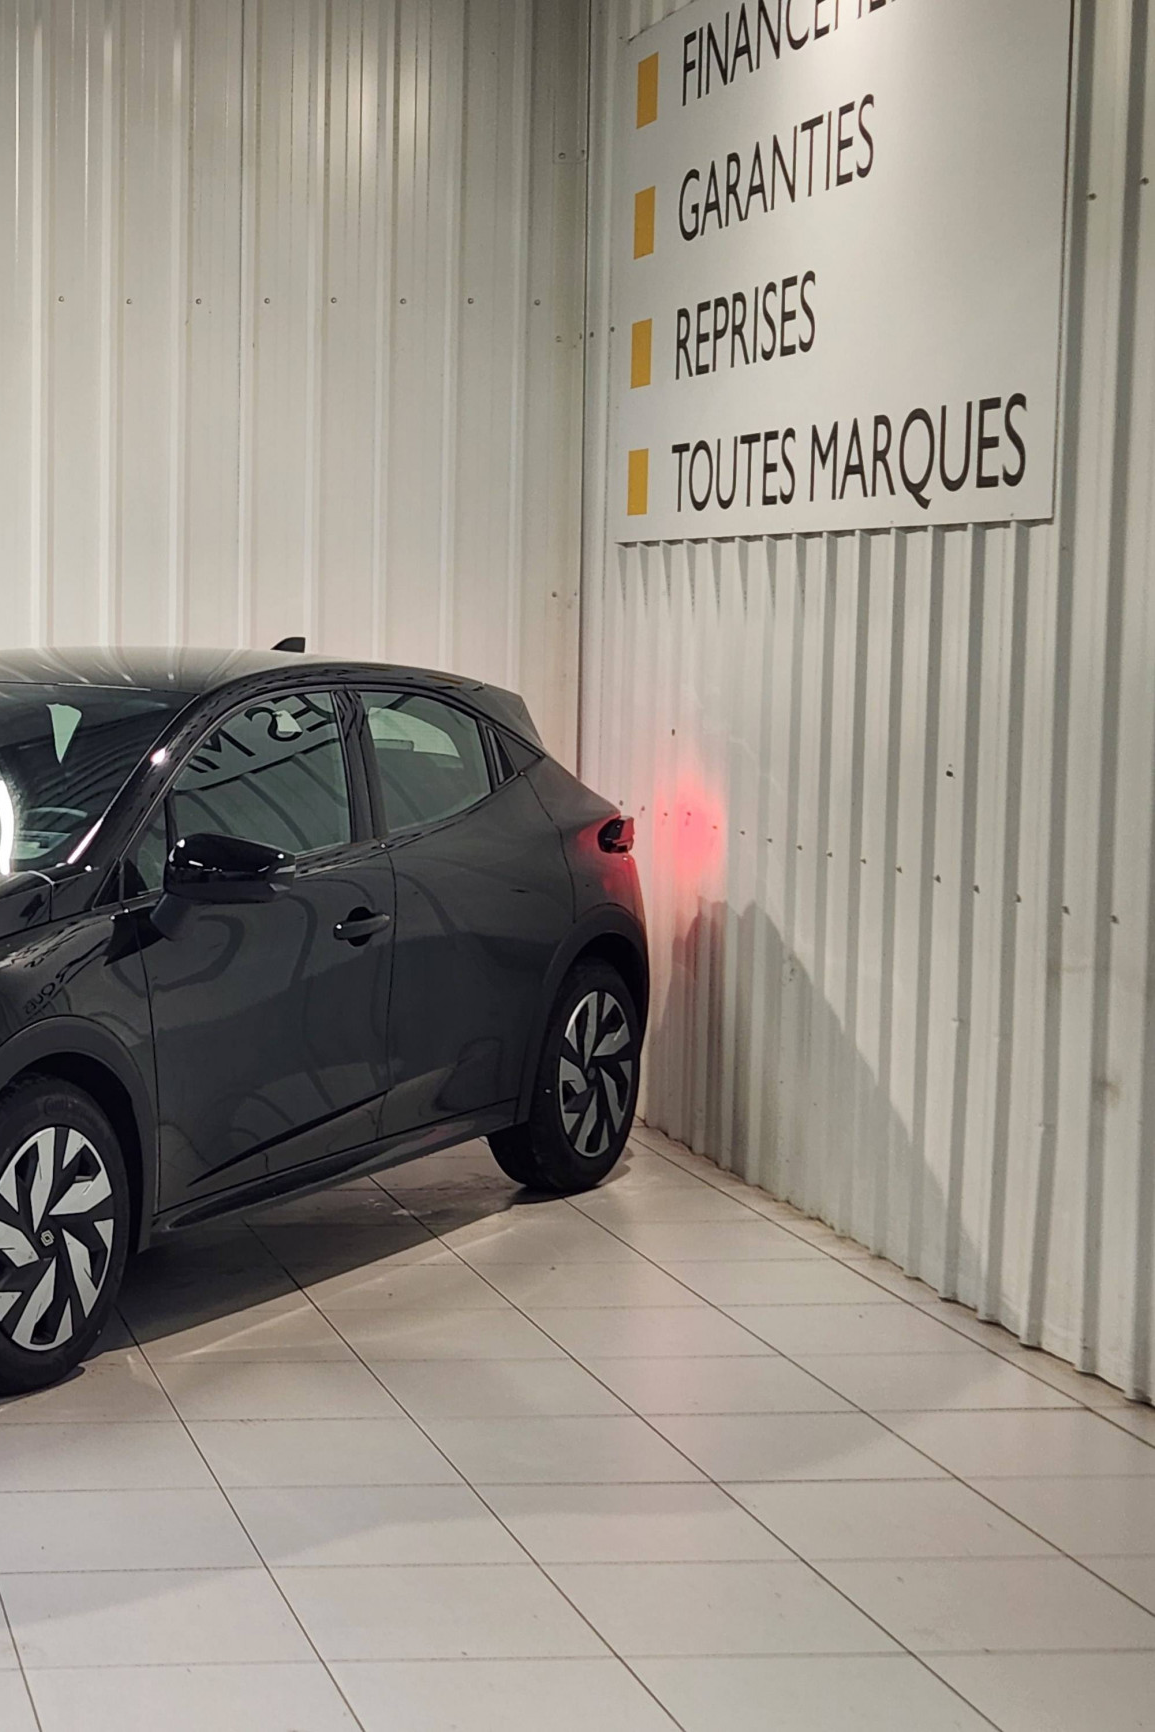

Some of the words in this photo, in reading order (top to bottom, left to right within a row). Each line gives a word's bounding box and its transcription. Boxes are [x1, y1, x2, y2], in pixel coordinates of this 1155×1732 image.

[681, 0, 895, 107] FINANC
[678, 93, 875, 242] GARANTIES
[675, 270, 816, 381] REPRISES
[671, 427, 796, 513] TOUTES
[809, 392, 1027, 510] MARQUES
